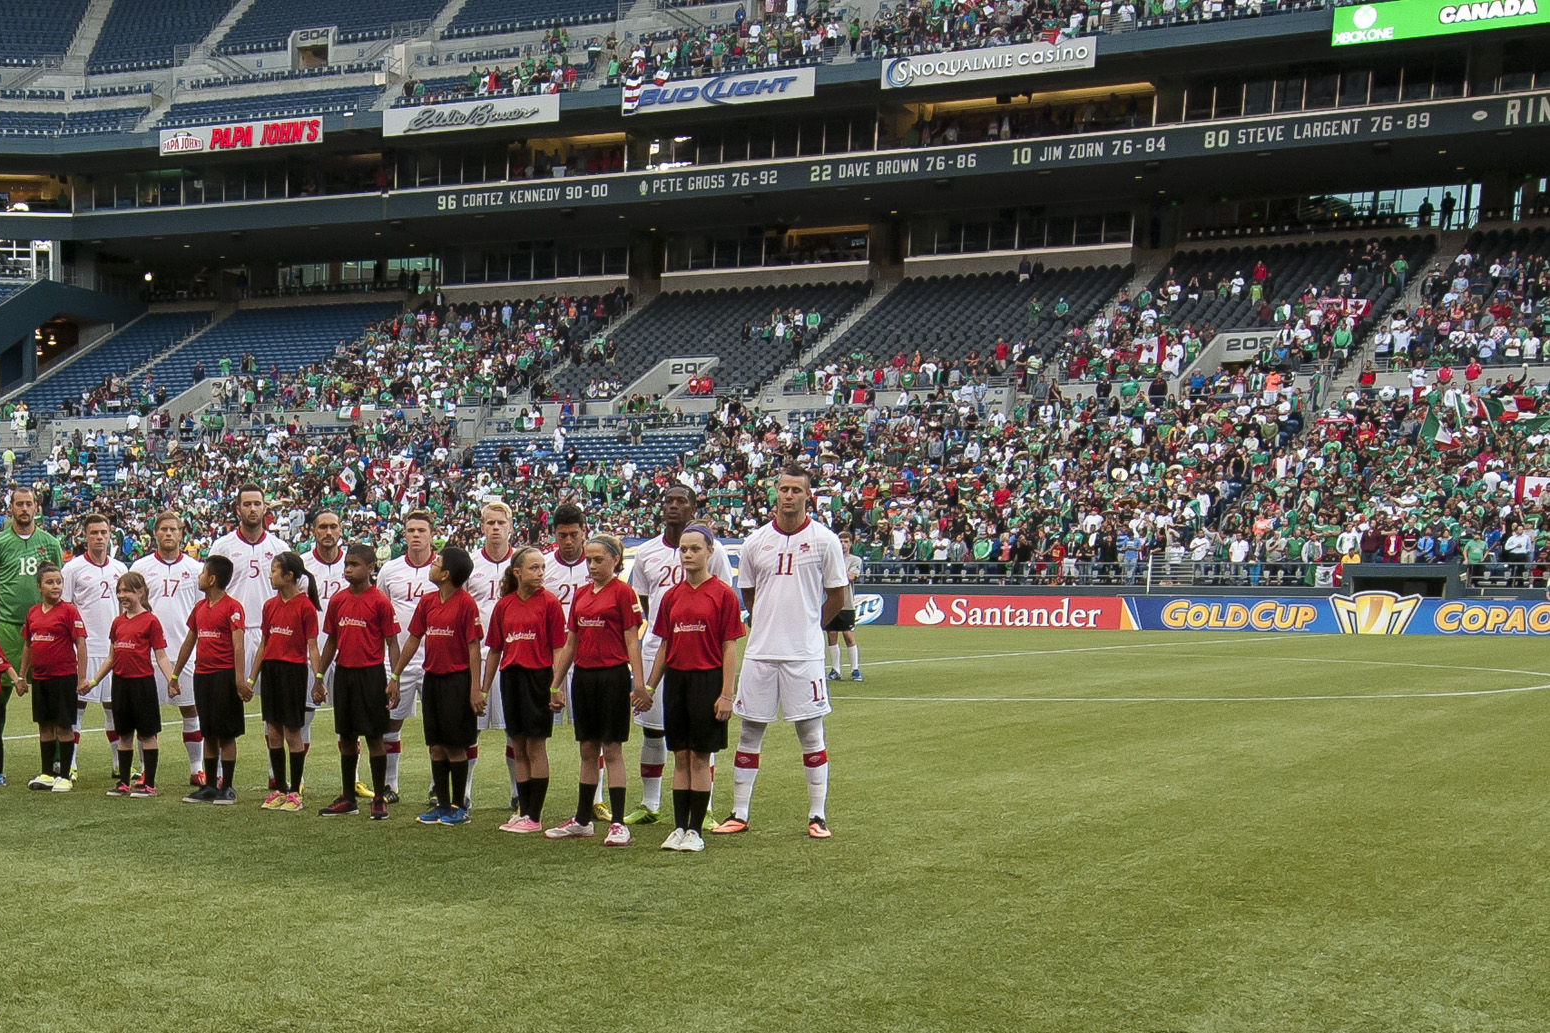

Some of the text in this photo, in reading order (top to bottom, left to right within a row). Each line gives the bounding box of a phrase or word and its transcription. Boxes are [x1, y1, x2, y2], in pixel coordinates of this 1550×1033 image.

[1439, 0, 1537, 24] CANADA
[299, 29, 330, 41] 304
[897, 45, 1088, 82] SNOQUALMIE casino
[639, 76, 798, 107] BUD LIGHT
[210, 120, 320, 150] PAPA JOHN'S
[1204, 112, 1430, 148] 80 STEVE LARGENT 76-89
[163, 137, 180, 151] PAPA
[1012, 136, 1166, 165] 10 JIM ZORN 76-84
[810, 153, 977, 182] 22 DAVE BROWN 76-86
[653, 170, 777, 194] PETE GROSS 76-92
[437, 184, 608, 210] 96 CORTEZ KENNEDY 90-00
[671, 362, 708, 374] 20
[19, 558, 38, 576] 18
[249, 559, 260, 578] 5
[659, 565, 685, 587] 20
[775, 553, 793, 575] 11
[100, 581, 110, 598] 2
[162, 579, 180, 597] 17
[407, 582, 424, 601] 14
[950, 597, 1102, 627] Santander
[811, 678, 825, 702] 11
